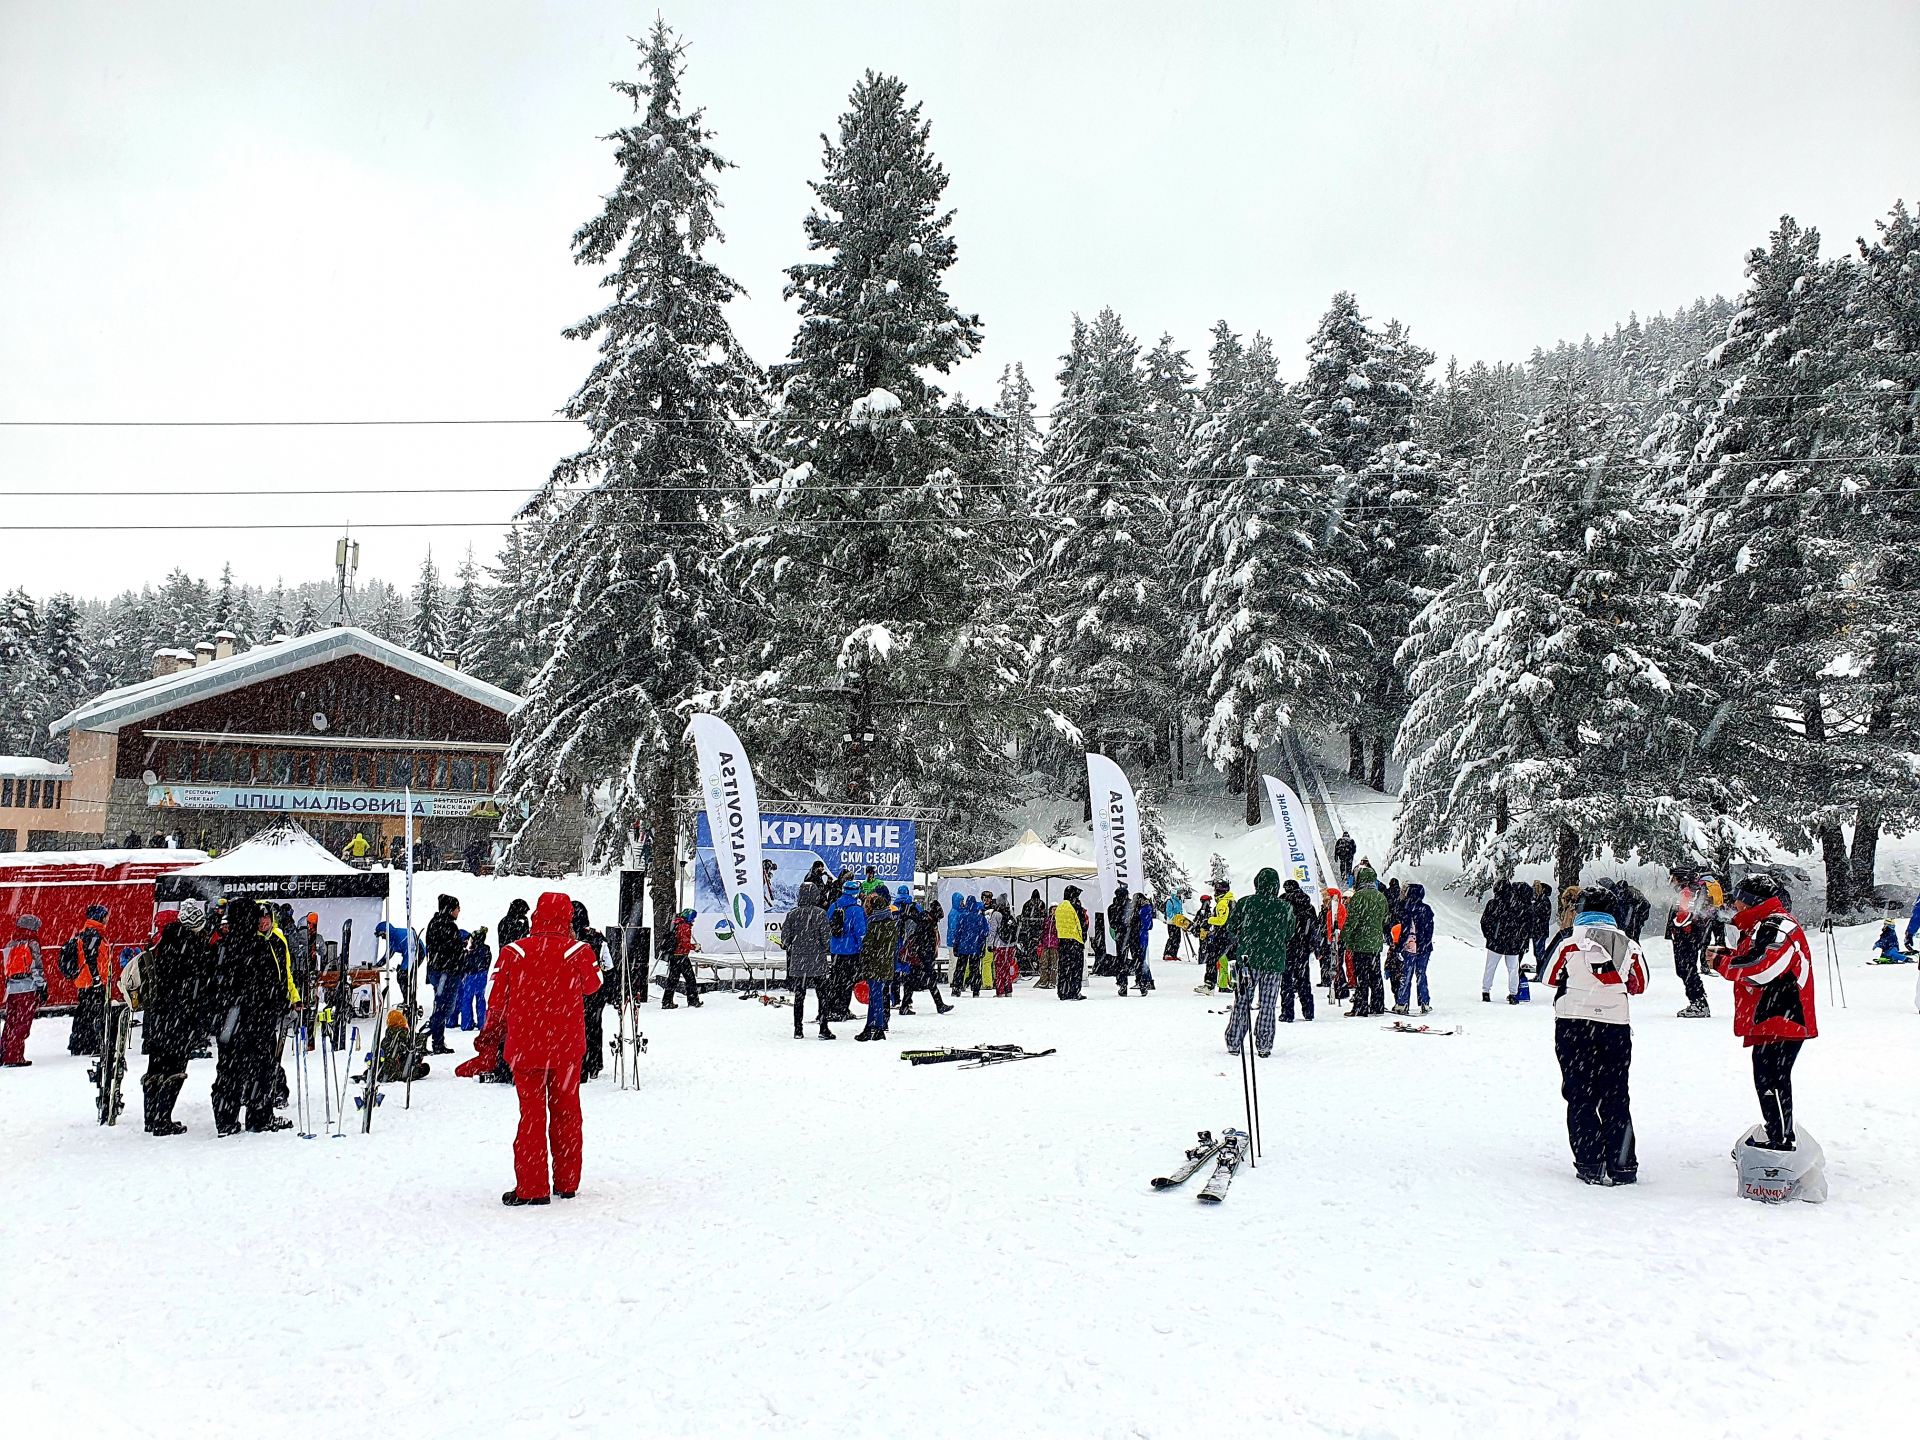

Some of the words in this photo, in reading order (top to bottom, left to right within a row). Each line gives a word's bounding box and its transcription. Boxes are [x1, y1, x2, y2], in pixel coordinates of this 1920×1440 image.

[235, 793, 285, 809] ЦПШ
[761, 820, 900, 848] КРИВАНЕ
[840, 851, 863, 863] СКИ
[866, 852, 900, 865] СЕЗОН
[223, 882, 278, 893] BIANCHI
[280, 881, 326, 891] COFFEE
[1745, 1183, 1793, 1198] Zakvas
